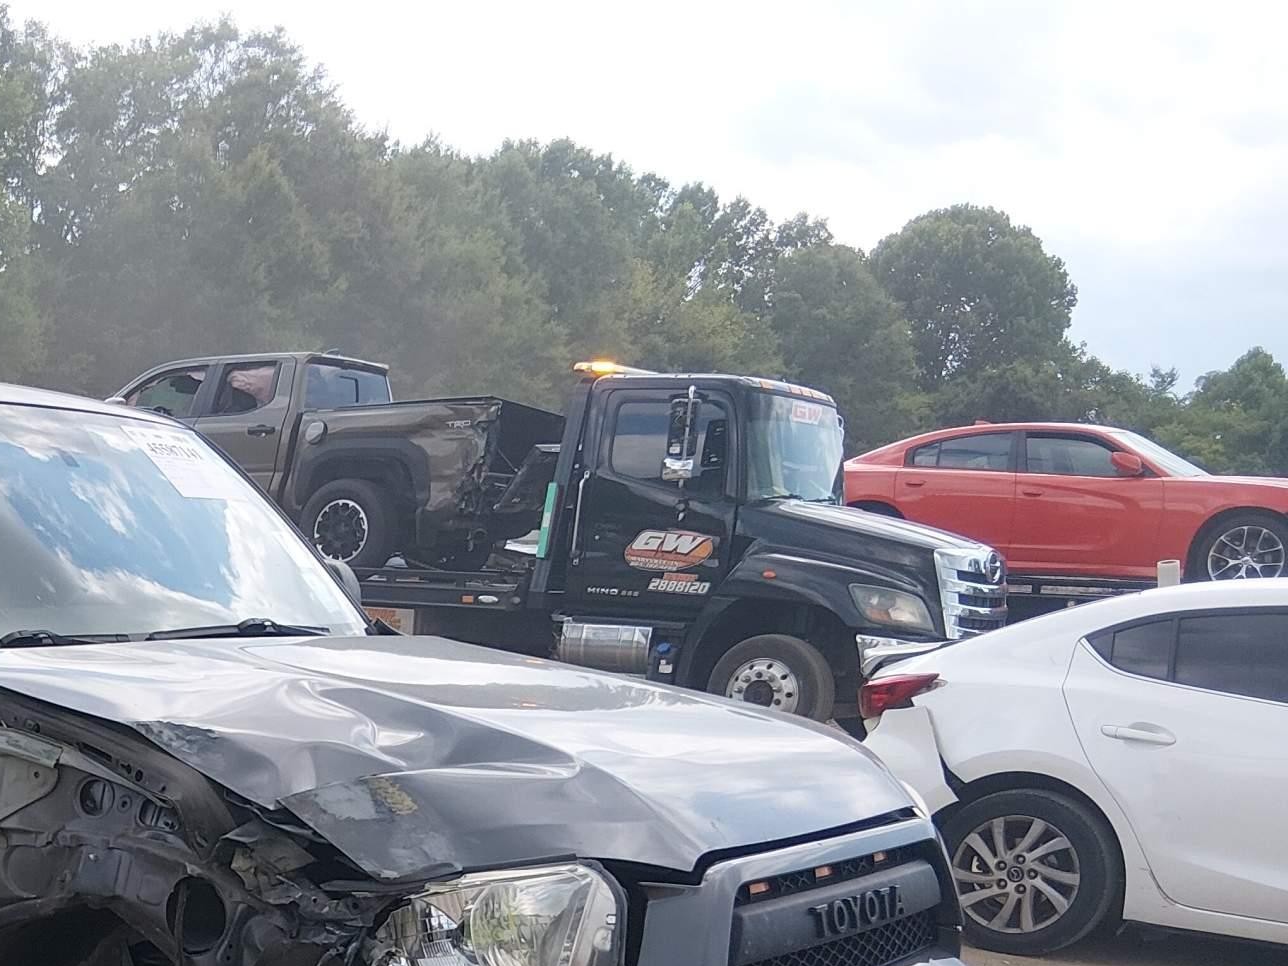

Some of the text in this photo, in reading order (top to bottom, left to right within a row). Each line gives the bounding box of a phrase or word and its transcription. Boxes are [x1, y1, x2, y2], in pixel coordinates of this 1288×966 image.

[445, 419, 471, 429] TRD
[792, 405, 822, 425] GW
[631, 530, 712, 555] GW
[586, 586, 619, 597] HINO
[809, 884, 906, 937] TOYOTA
